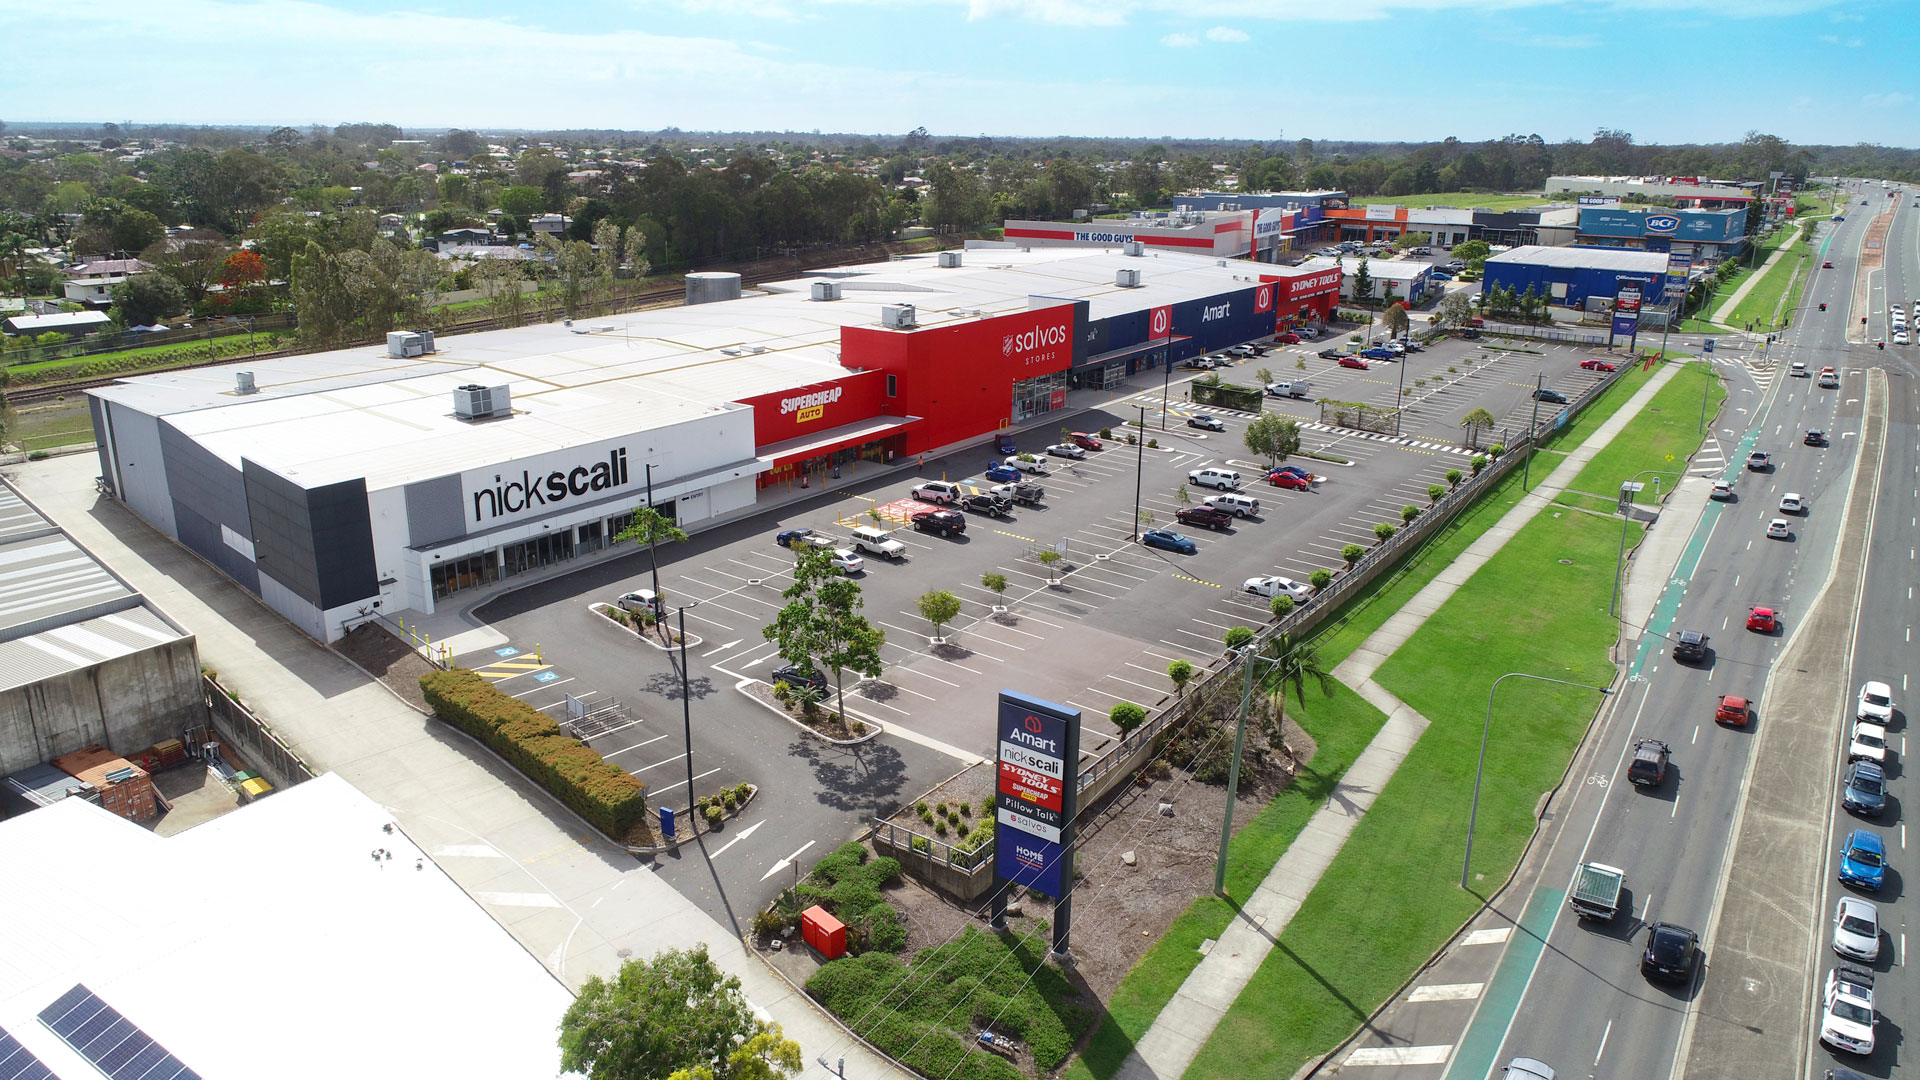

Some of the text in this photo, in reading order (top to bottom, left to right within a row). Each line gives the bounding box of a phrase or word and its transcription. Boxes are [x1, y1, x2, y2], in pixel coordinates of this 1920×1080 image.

[1650, 219, 1675, 228] BCF
[1076, 232, 1134, 243] THE GOOD GUYS
[1291, 272, 1340, 293] SYDNEY TOOLS
[1202, 301, 1230, 322] Amart
[1015, 324, 1066, 353] salvos
[1025, 351, 1056, 366] STORES
[780, 386, 842, 415] SUPERCHEAP
[800, 408, 821, 420] AUTO
[1010, 727, 1056, 753] Amart
[1001, 763, 1050, 783] SYDNEY
[1012, 782, 1049, 800] SUPERCHEAP
[1021, 775, 1059, 794] TOOLS
[1022, 792, 1037, 801] AUTO
[1005, 797, 1054, 821] Pillow Talk
[1017, 814, 1047, 833] salvos
[1016, 845, 1044, 862] HOME
